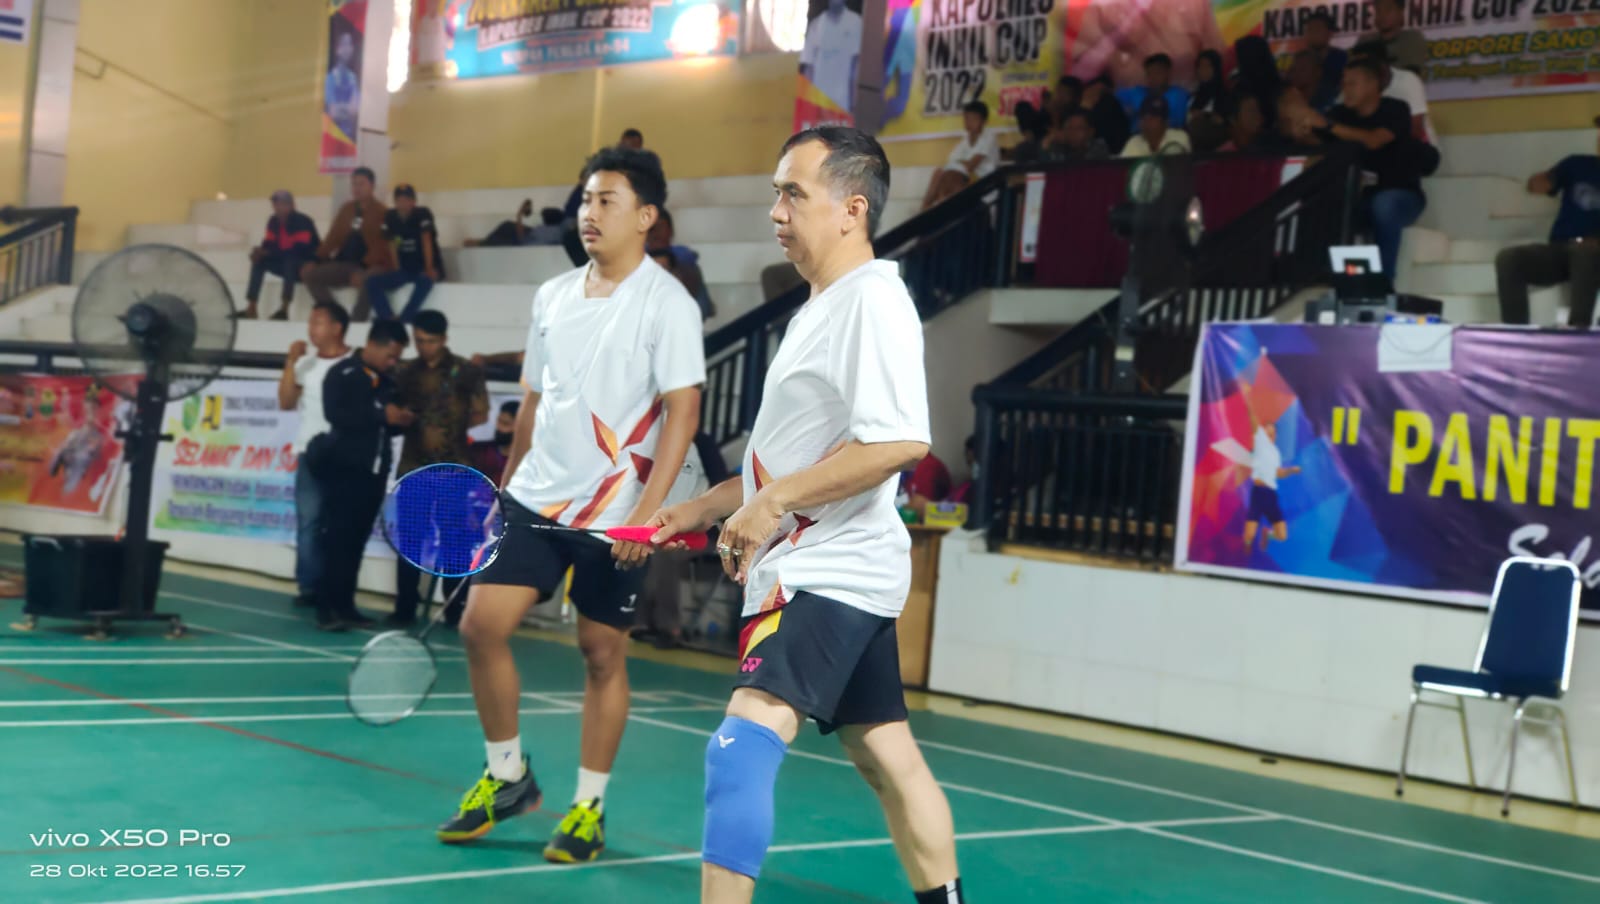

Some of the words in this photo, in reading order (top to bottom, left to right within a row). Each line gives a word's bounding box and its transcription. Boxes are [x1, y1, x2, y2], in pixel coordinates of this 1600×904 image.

[1262, 2, 1376, 38] KAPLRE
[1407, 0, 1465, 28] NHIL
[926, 24, 988, 69] INHIL
[996, 17, 1048, 64] CUP
[924, 68, 986, 113] 2022
[172, 437, 241, 467] SELAMAT
[1388, 409, 1600, 510] PANIT
